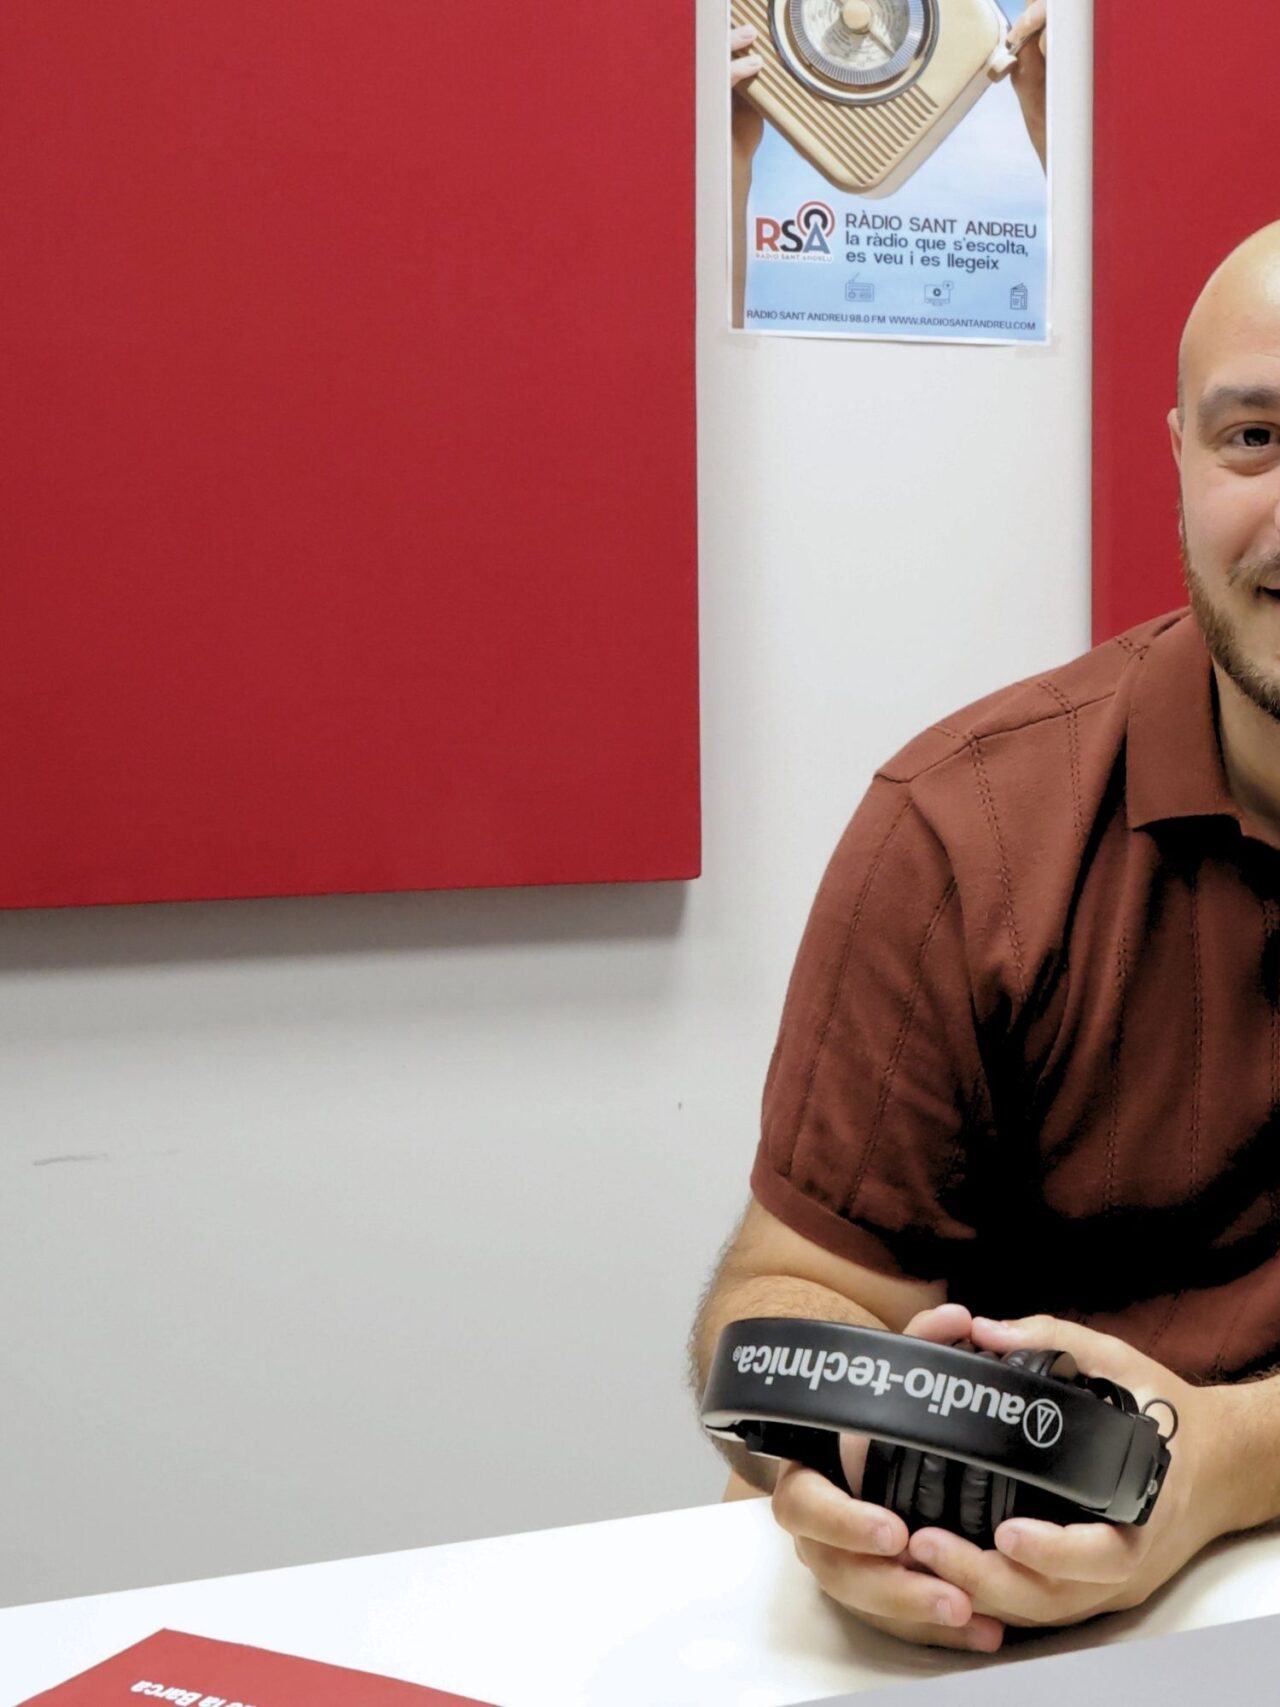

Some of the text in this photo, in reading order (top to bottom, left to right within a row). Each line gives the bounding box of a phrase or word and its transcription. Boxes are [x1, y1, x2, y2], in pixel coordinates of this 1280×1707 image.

[756, 216, 831, 255] RSA
[845, 210, 1037, 239] RÀDIO SANT ANDREU
[845, 231, 1029, 257] la ràdio que s'escolta,
[846, 251, 867, 264] es
[874, 253, 903, 266] veu
[921, 255, 941, 267] es
[947, 253, 1000, 274] llegeix
[779, 312, 806, 321] SANT
[807, 313, 848, 322] ANDREU
[871, 315, 886, 324] FM
[131, 1680, 203, 1706] Barca
